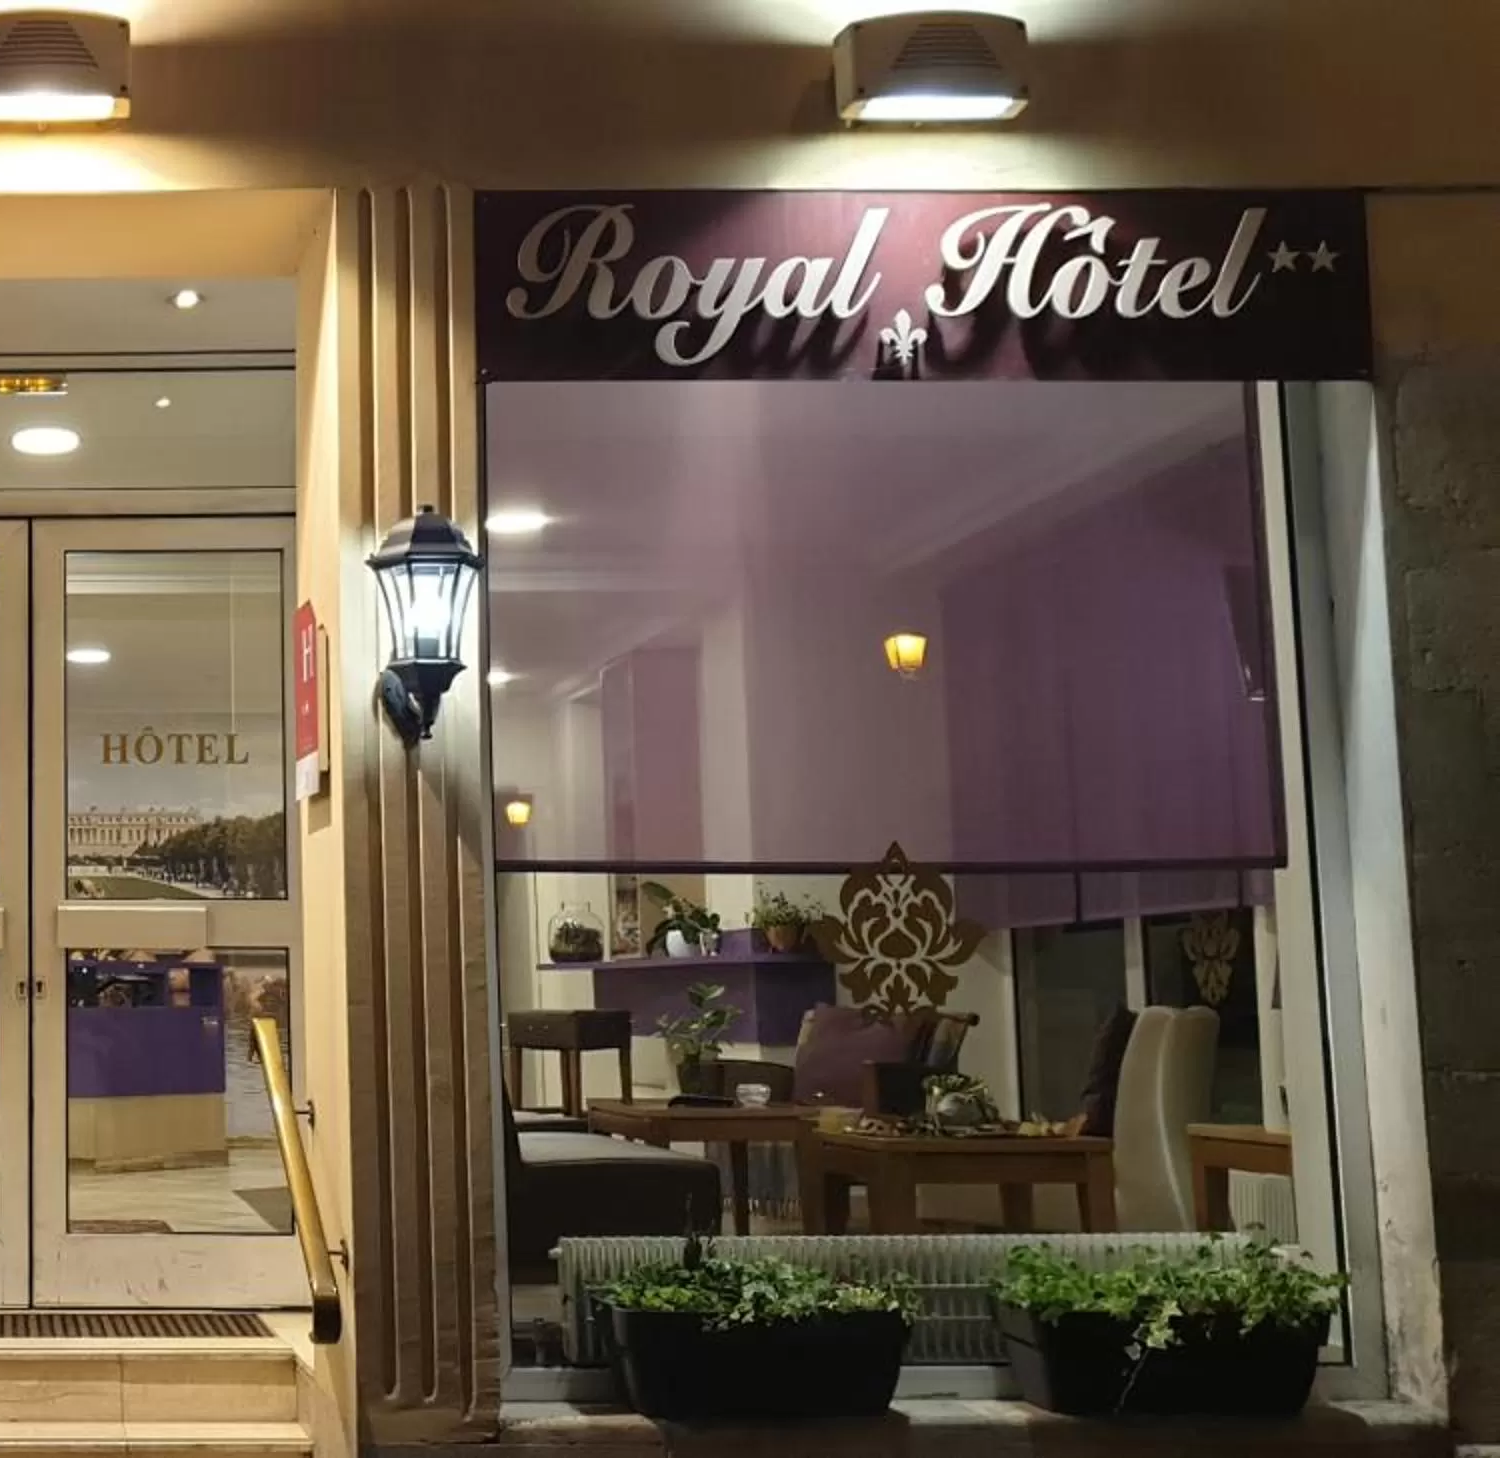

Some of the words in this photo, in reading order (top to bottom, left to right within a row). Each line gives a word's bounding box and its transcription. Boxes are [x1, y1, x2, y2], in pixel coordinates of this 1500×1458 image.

[505, 203, 890, 367] Royal
[925, 202, 1268, 320] Hôtel
[301, 623, 314, 684] H
[101, 726, 249, 764] HÔTEL
